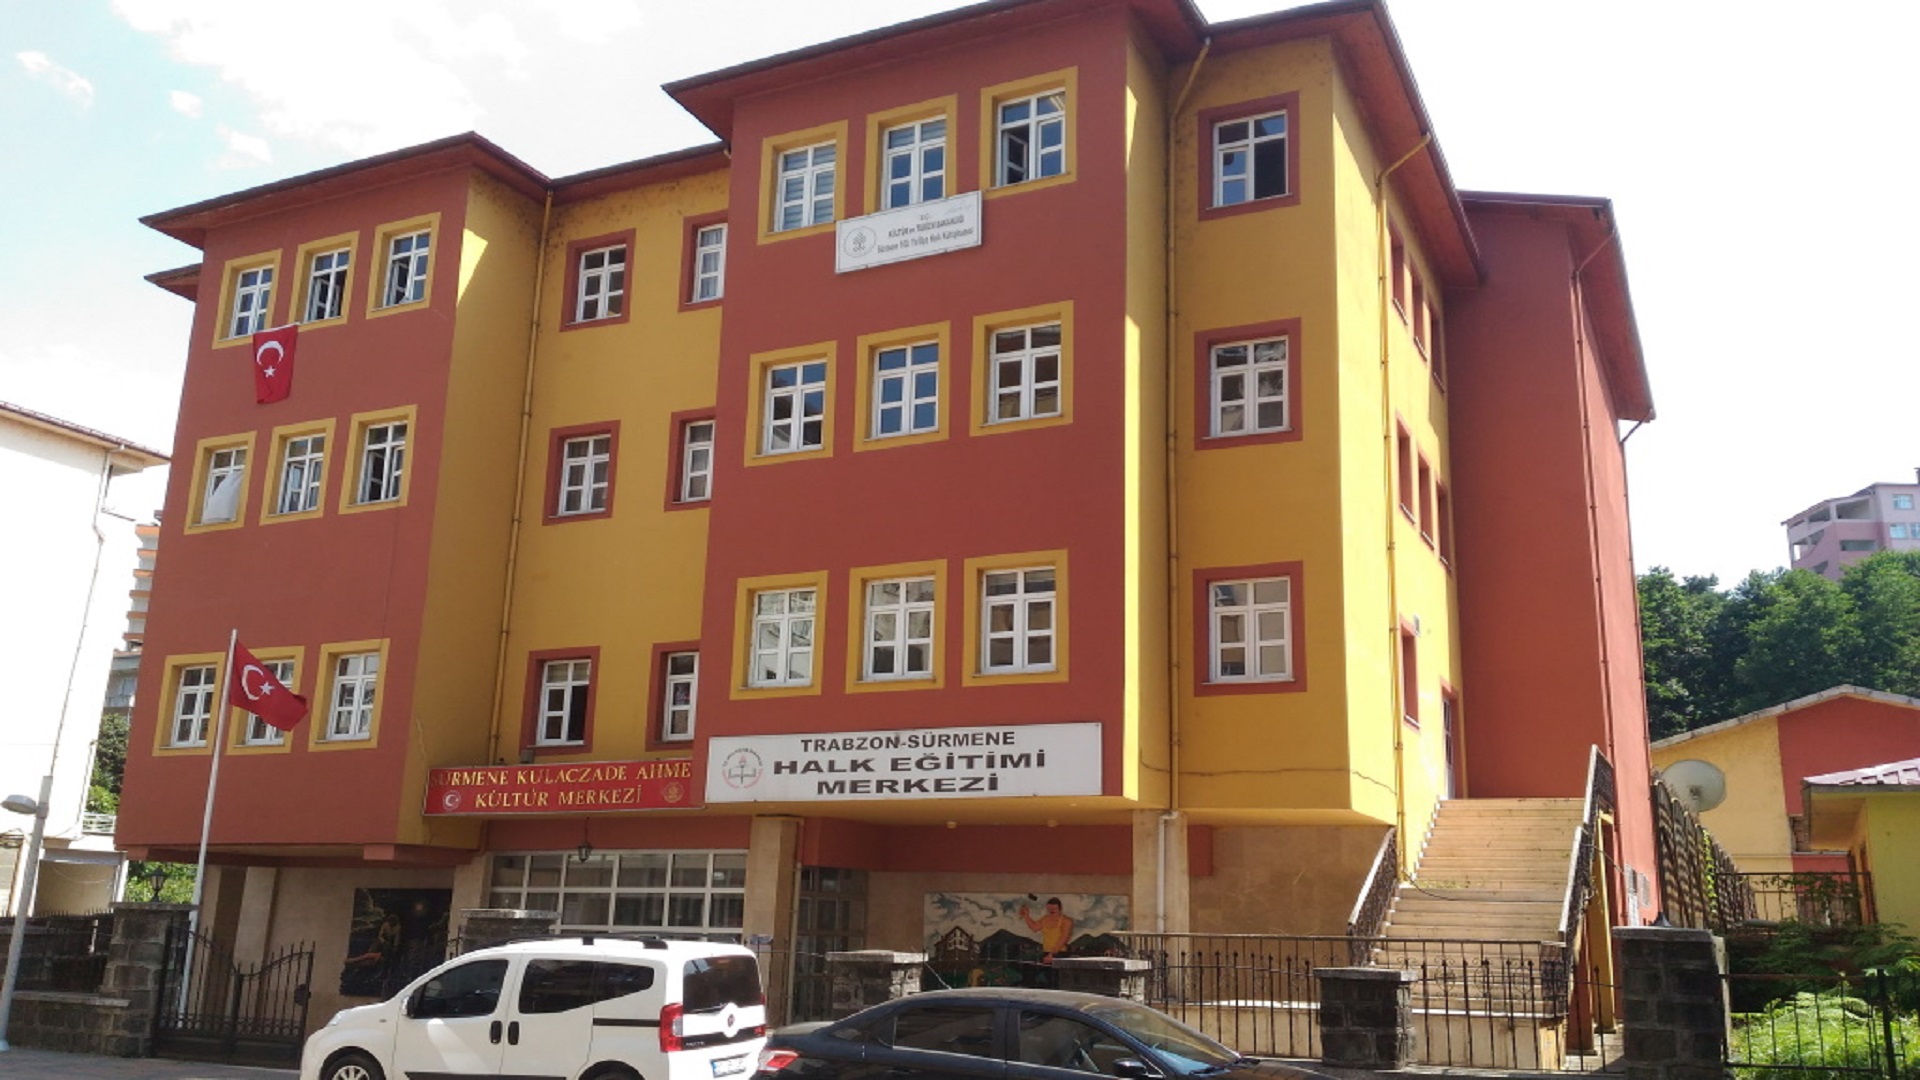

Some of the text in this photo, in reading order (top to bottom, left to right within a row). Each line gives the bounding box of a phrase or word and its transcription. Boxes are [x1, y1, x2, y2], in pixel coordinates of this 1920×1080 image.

[801, 731, 1016, 753] TRABZON-SÜRMENE
[635, 762, 692, 780] AHME
[773, 748, 1046, 775] HALK EĞİTİMİ
[475, 784, 641, 808] KÜLTÜR MERKEZİ
[817, 773, 999, 796] MERKEZİ
